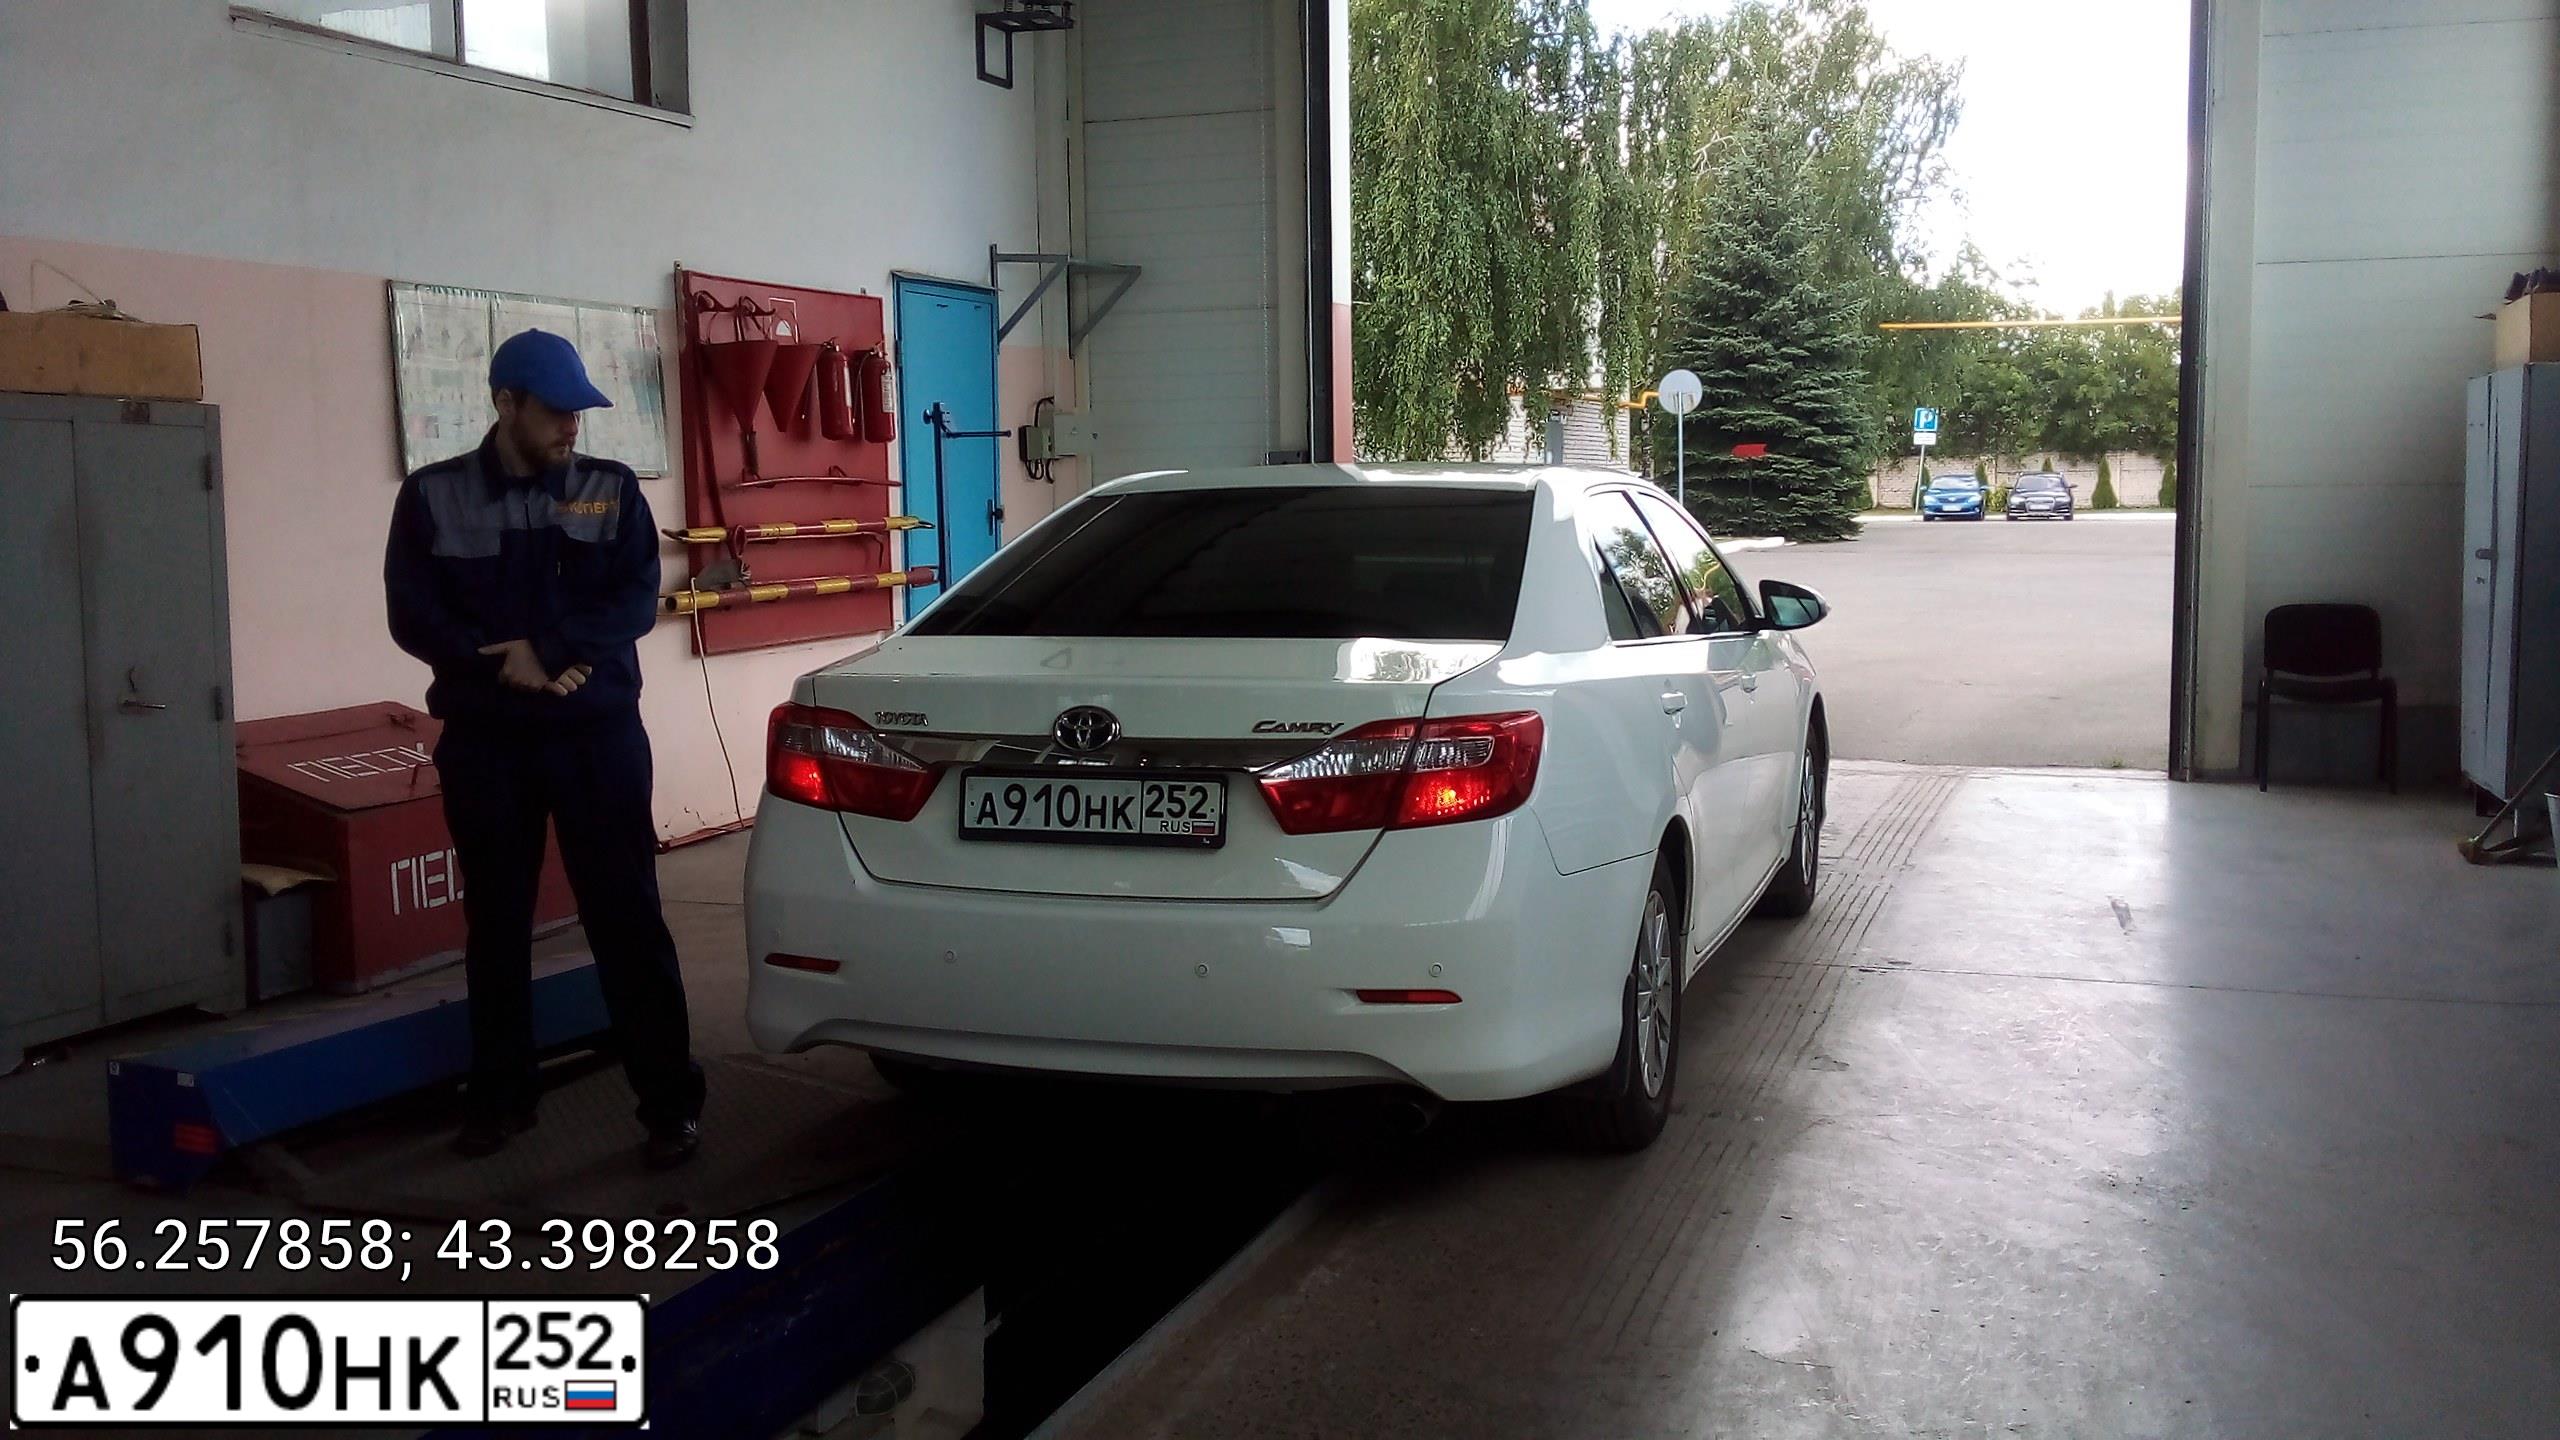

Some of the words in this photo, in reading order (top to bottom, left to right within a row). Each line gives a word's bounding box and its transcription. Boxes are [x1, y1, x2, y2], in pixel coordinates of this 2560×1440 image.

[875, 711, 929, 727] TOYOTA
[1252, 720, 1345, 735] CAMRY
[976, 783, 1136, 831] А910НК
[1145, 784, 1209, 819] 252
[1159, 820, 1191, 833] RUS
